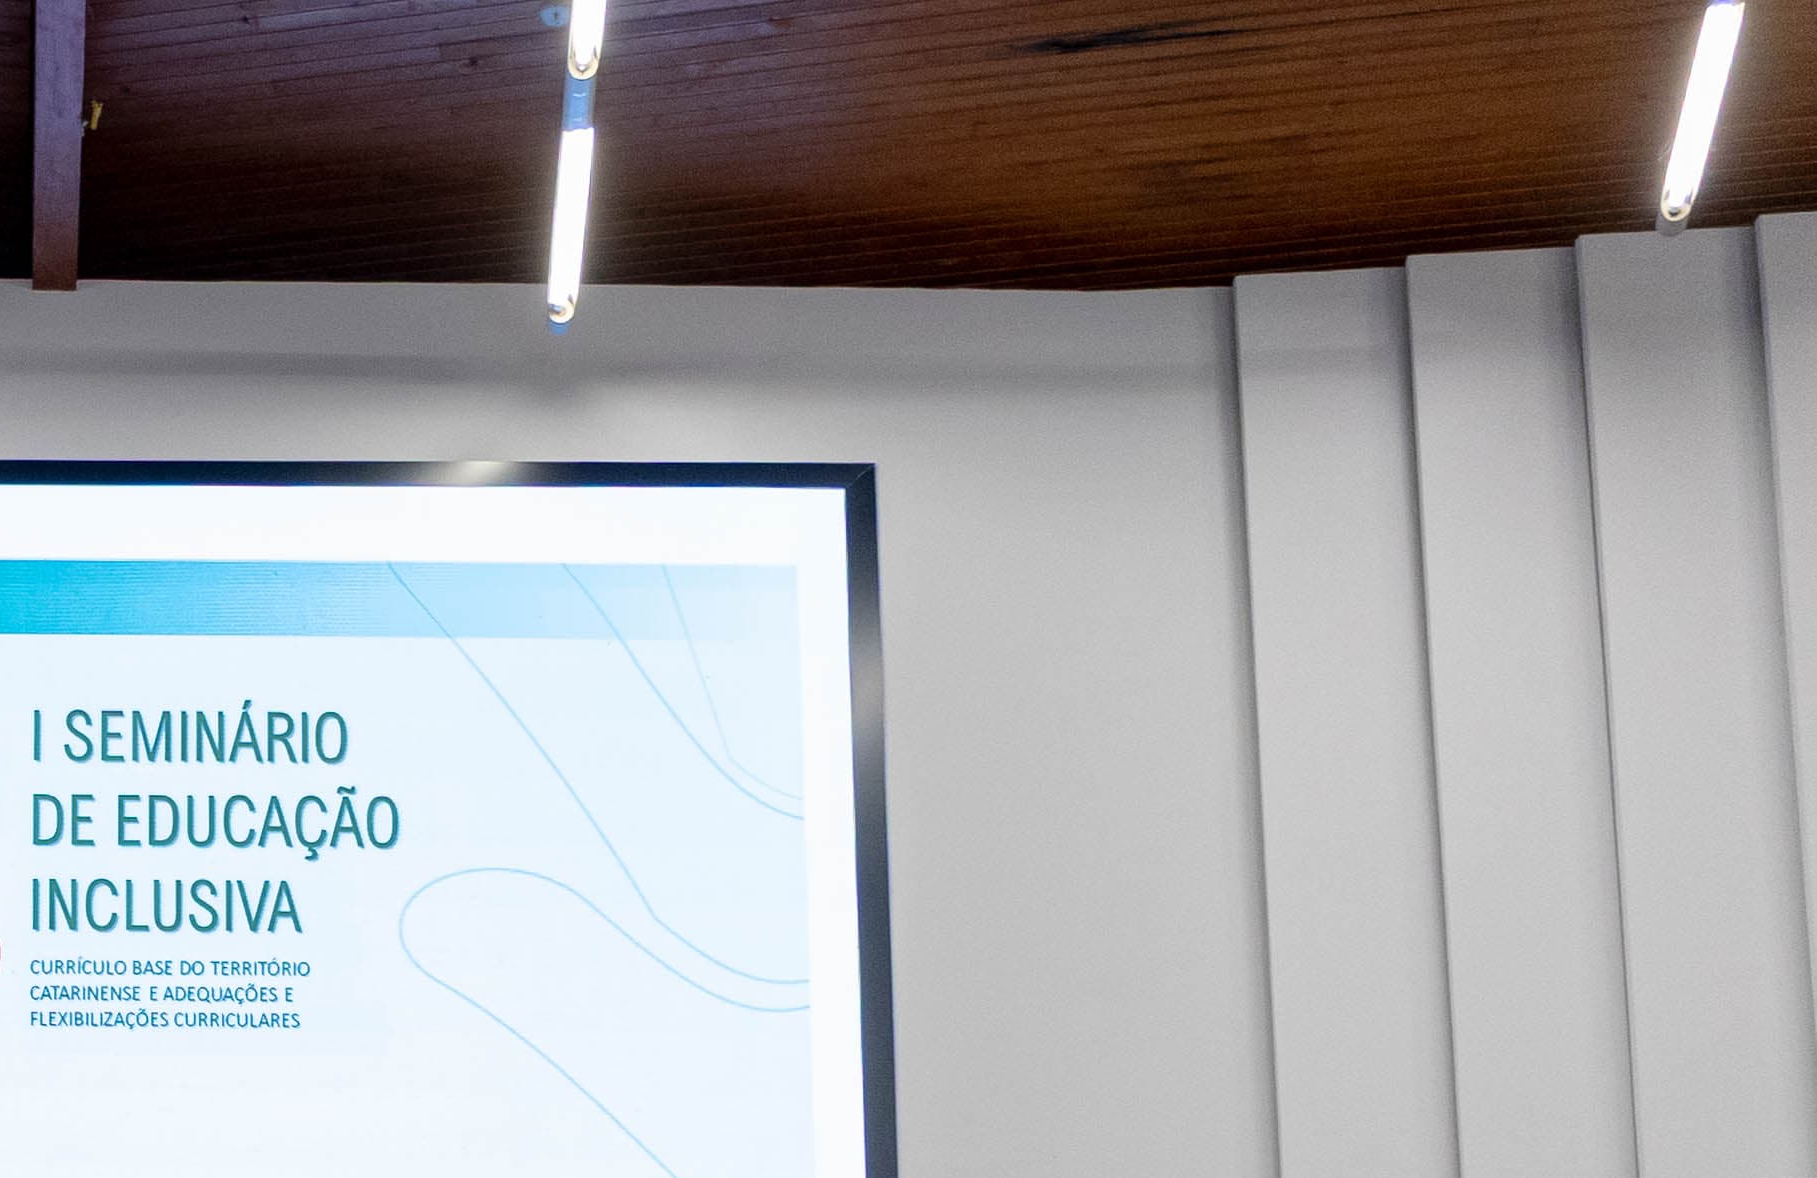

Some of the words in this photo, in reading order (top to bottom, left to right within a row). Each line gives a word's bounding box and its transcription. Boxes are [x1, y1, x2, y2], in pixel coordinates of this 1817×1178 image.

[33, 709, 43, 764] I
[62, 699, 350, 766] SEMINÁRIO
[32, 793, 96, 848] DE
[117, 785, 401, 861] EDUCAÇÃO
[31, 878, 303, 934] INCLUSIVA
[29, 956, 128, 976] CURRÍCULO
[132, 959, 173, 976] BASE
[180, 959, 205, 977] DO
[209, 957, 311, 977] TERRITÓRIO
[29, 984, 141, 1002] CATARINENSE
[149, 985, 158, 1002] E
[162, 982, 279, 1006] ADEQUAÇÕES
[285, 986, 294, 1003] E
[29, 1008, 170, 1030] FLEXIBILIZAÇÕES
[173, 1011, 301, 1029] CURRICULARES
